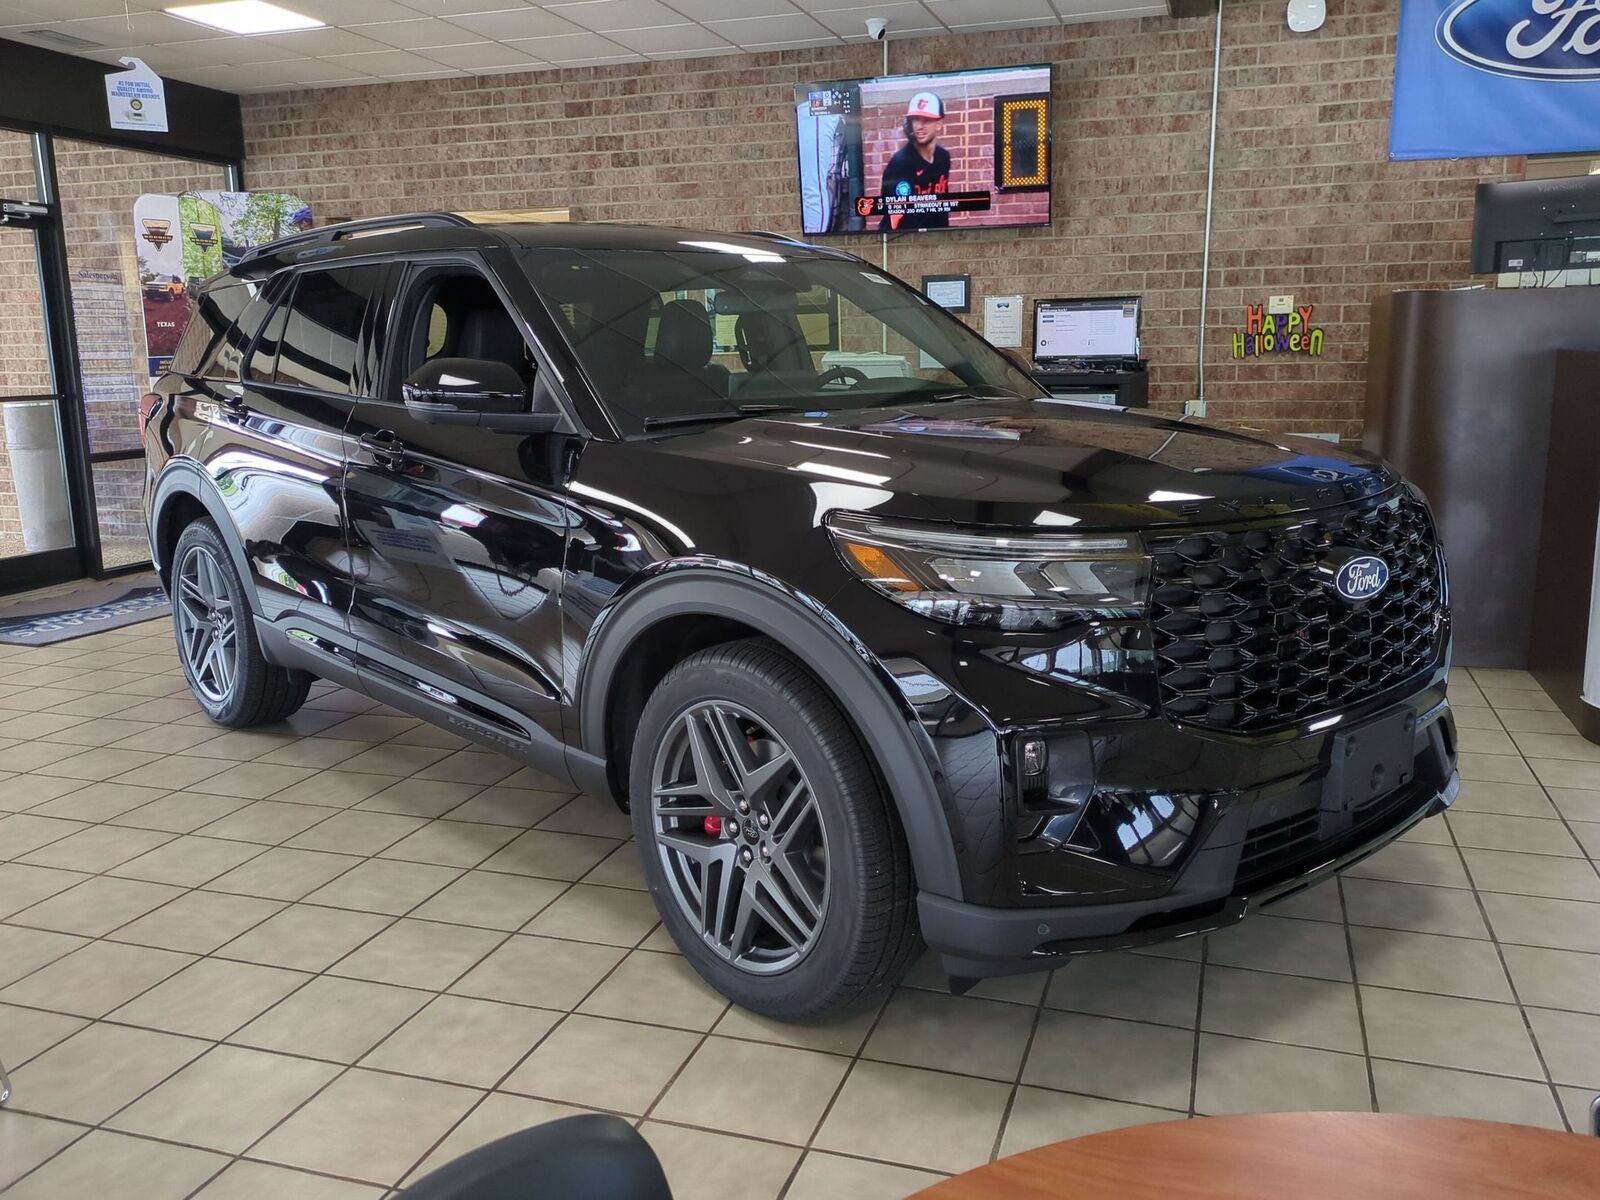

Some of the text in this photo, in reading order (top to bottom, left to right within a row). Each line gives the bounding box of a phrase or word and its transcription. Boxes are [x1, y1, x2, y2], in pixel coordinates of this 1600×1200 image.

[1506, 0, 1600, 59] Fo
[908, 194, 937, 202] BEAVERS
[78, 270, 118, 280] Salesperson
[1246, 303, 1314, 336] HAPPY
[1347, 561, 1381, 594] Ford
